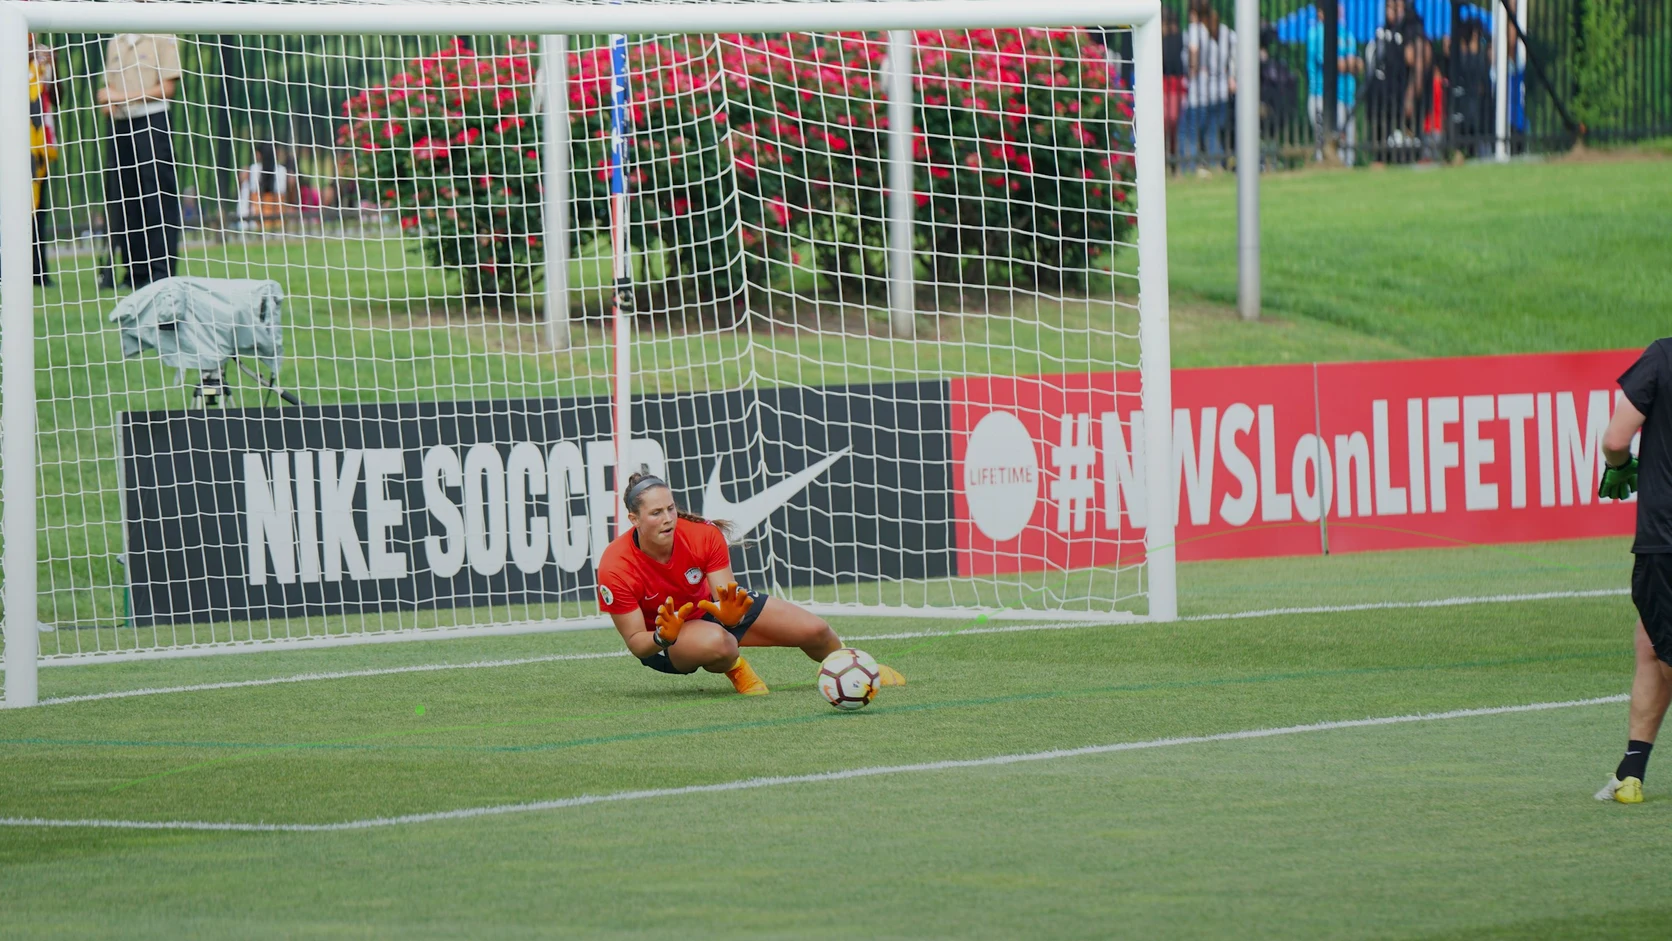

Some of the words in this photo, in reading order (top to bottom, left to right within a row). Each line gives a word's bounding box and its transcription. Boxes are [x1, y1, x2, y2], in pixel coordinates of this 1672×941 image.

[243, 447, 408, 586] NIKE
[969, 465, 1033, 486] LIFETIME
[1049, 388, 1640, 533] #NWSLonLIFETIM
